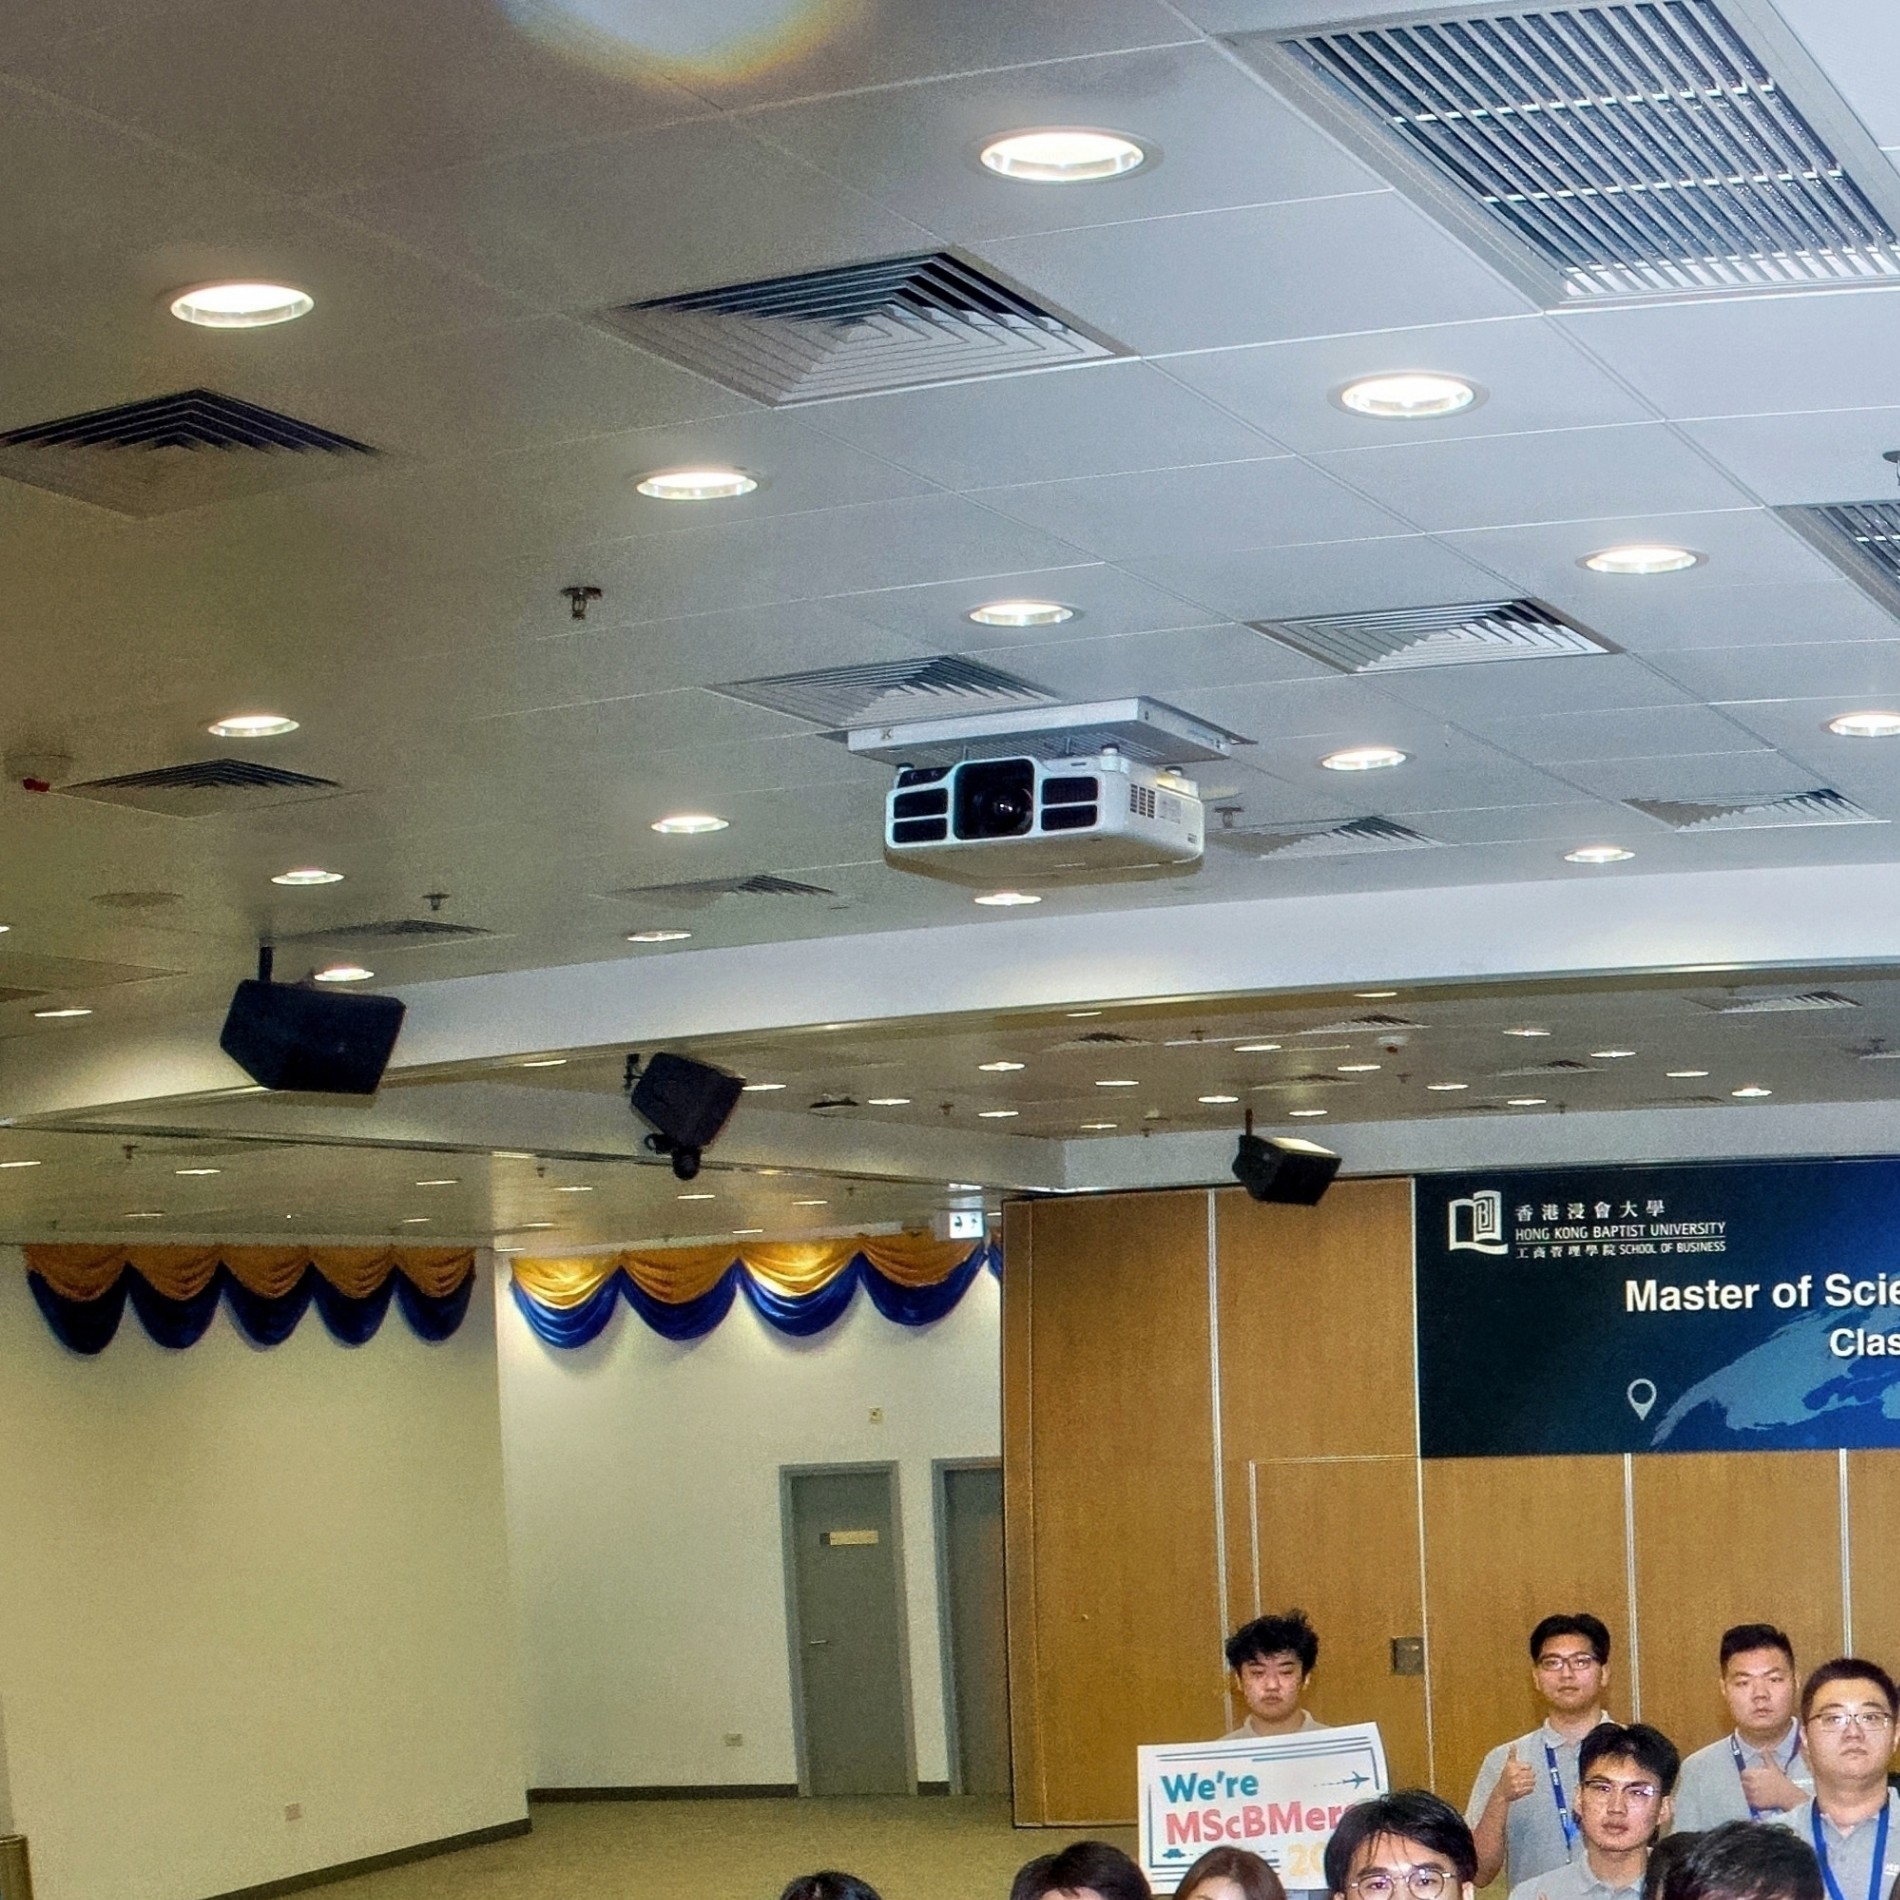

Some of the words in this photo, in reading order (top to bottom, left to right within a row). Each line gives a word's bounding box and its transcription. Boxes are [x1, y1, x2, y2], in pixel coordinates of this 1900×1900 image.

[1515, 1226, 1550, 1241] HONG
[1553, 1225, 1588, 1240] KONG
[1592, 1223, 1645, 1239] BAPTIST
[1650, 1221, 1726, 1237] UNIVERSITY
[1619, 1243, 1656, 1255] SCHOOL
[1660, 1243, 1673, 1254] OF
[1676, 1240, 1726, 1252] BUSINESS
[1625, 1280, 1755, 1312] Master
[1771, 1280, 1813, 1307] of
[1160, 1770, 1260, 1804] We're
